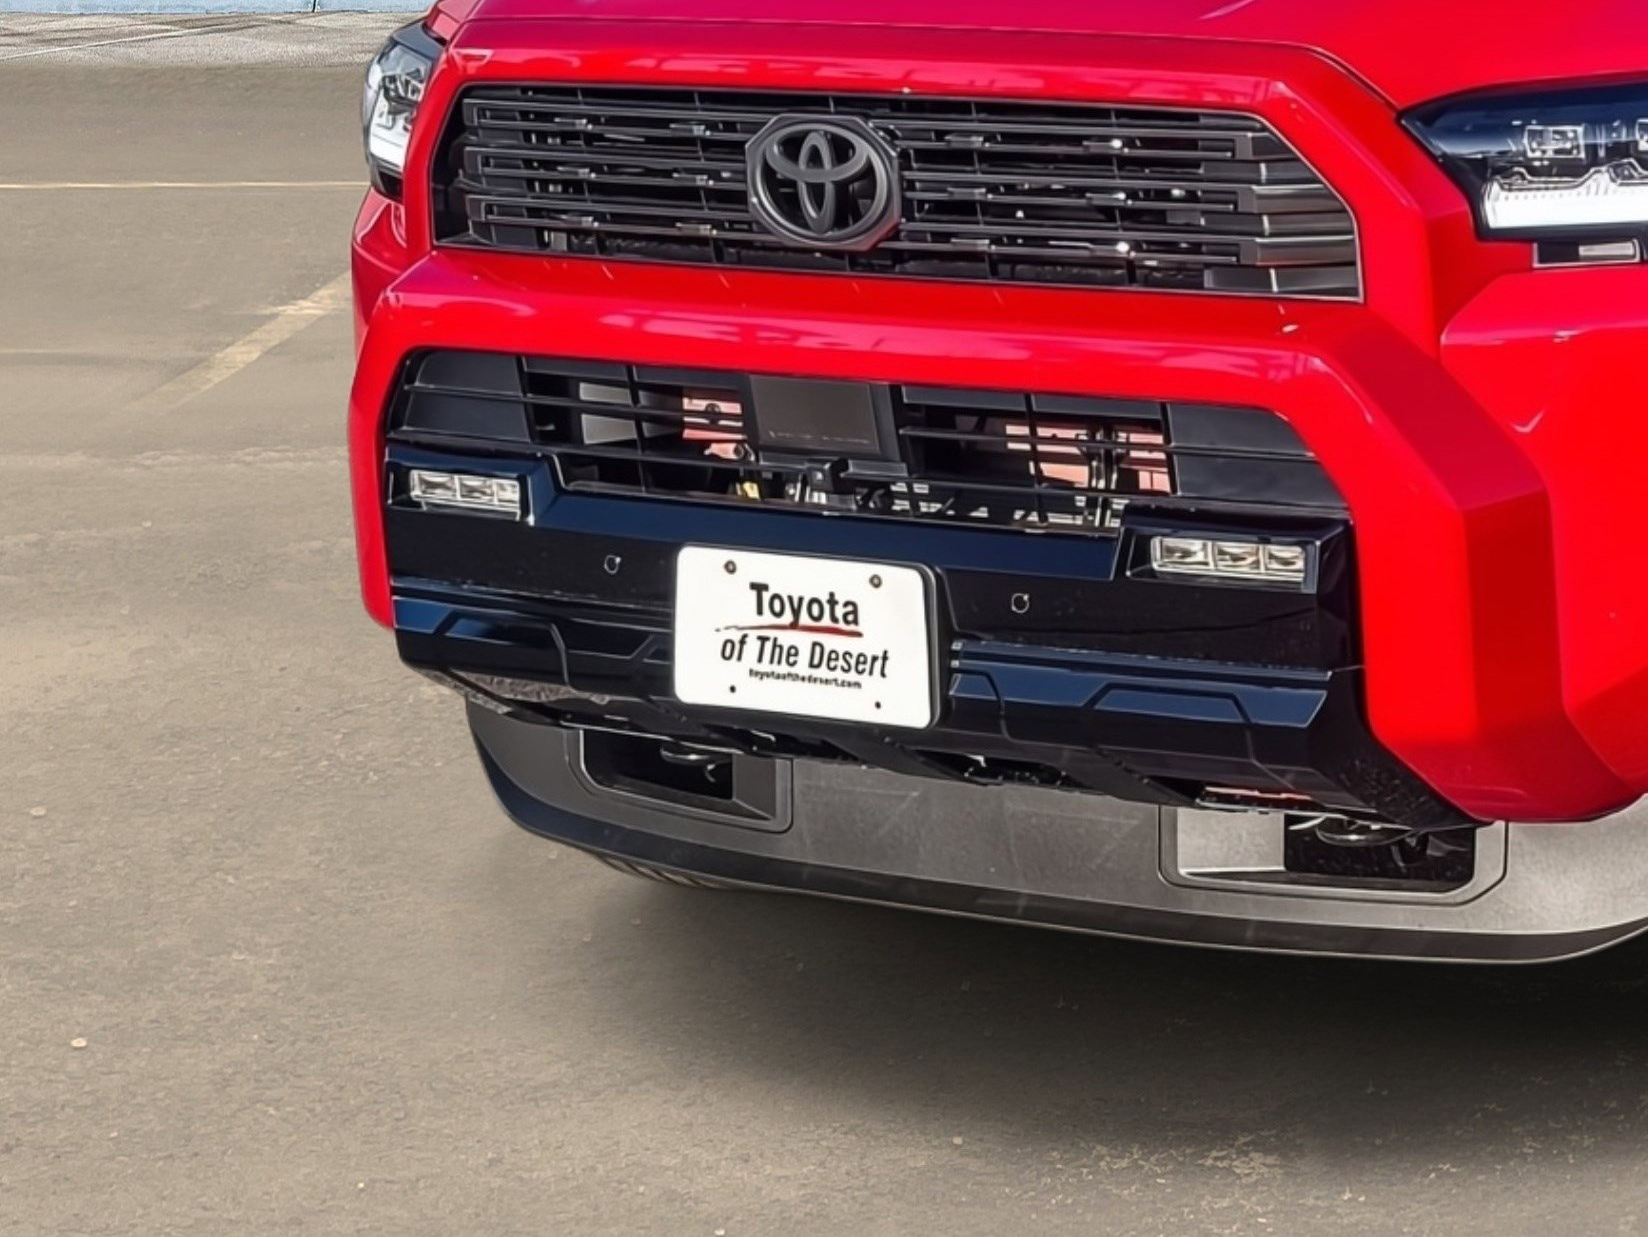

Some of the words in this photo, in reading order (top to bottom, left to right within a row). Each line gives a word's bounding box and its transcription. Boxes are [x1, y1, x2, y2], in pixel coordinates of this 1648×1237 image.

[750, 581, 859, 629] Toyota
[721, 634, 749, 661] of
[756, 636, 799, 667] The
[808, 640, 888, 678] Desert
